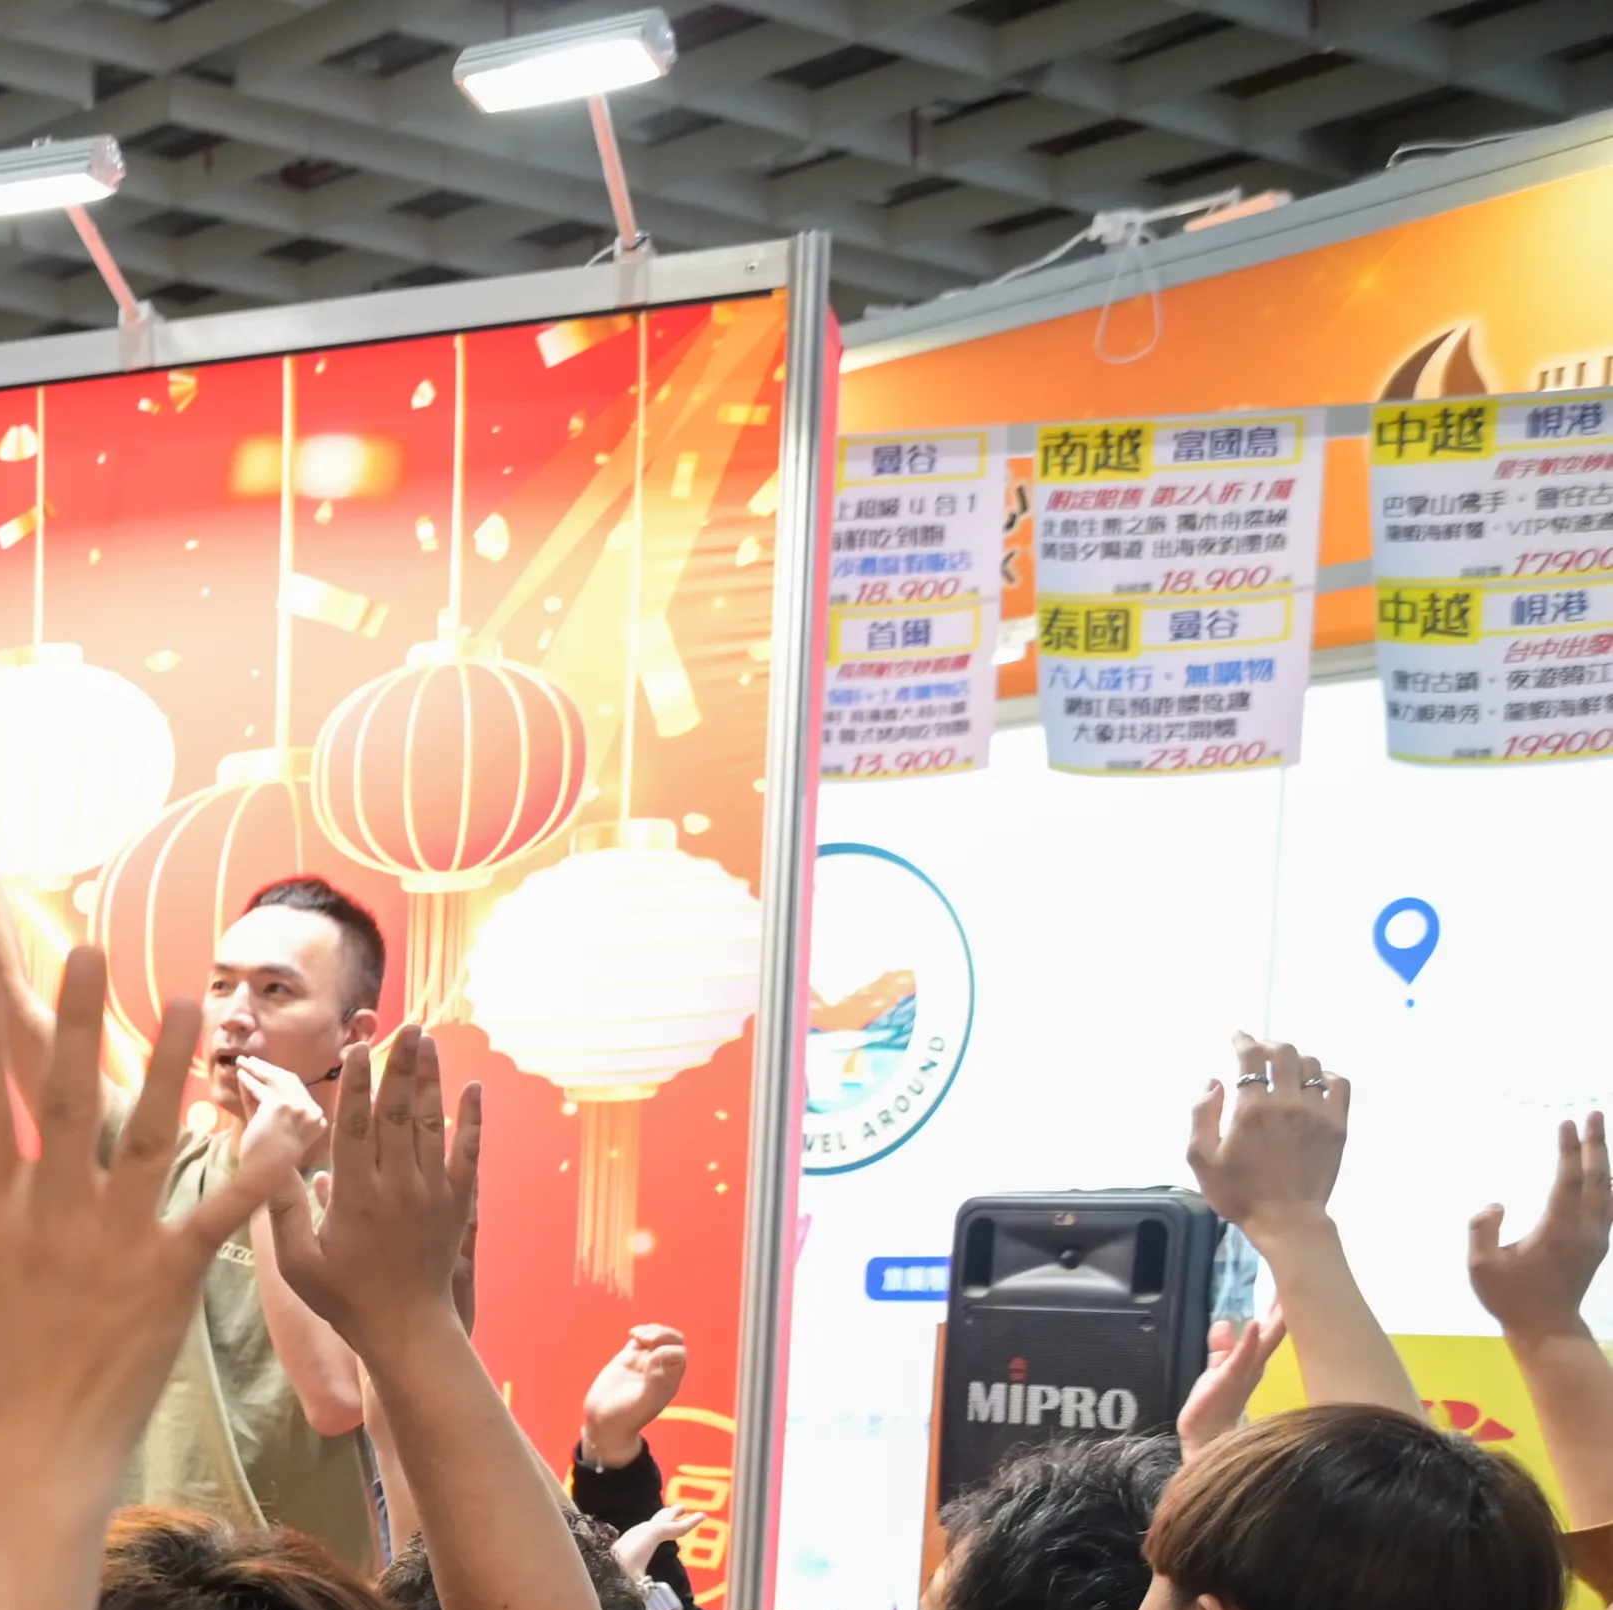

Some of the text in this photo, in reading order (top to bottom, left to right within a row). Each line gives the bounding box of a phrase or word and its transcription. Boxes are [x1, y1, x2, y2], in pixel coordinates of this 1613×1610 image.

[1040, 425, 1280, 477] 南越 富國島
[1377, 403, 1604, 458] 中越 峴港
[866, 618, 932, 651] 首爾
[1040, 606, 1239, 652] 泰國 曼谷
[1379, 590, 1589, 638] 中越 峴港
[862, 1036, 945, 1142] AROUND
